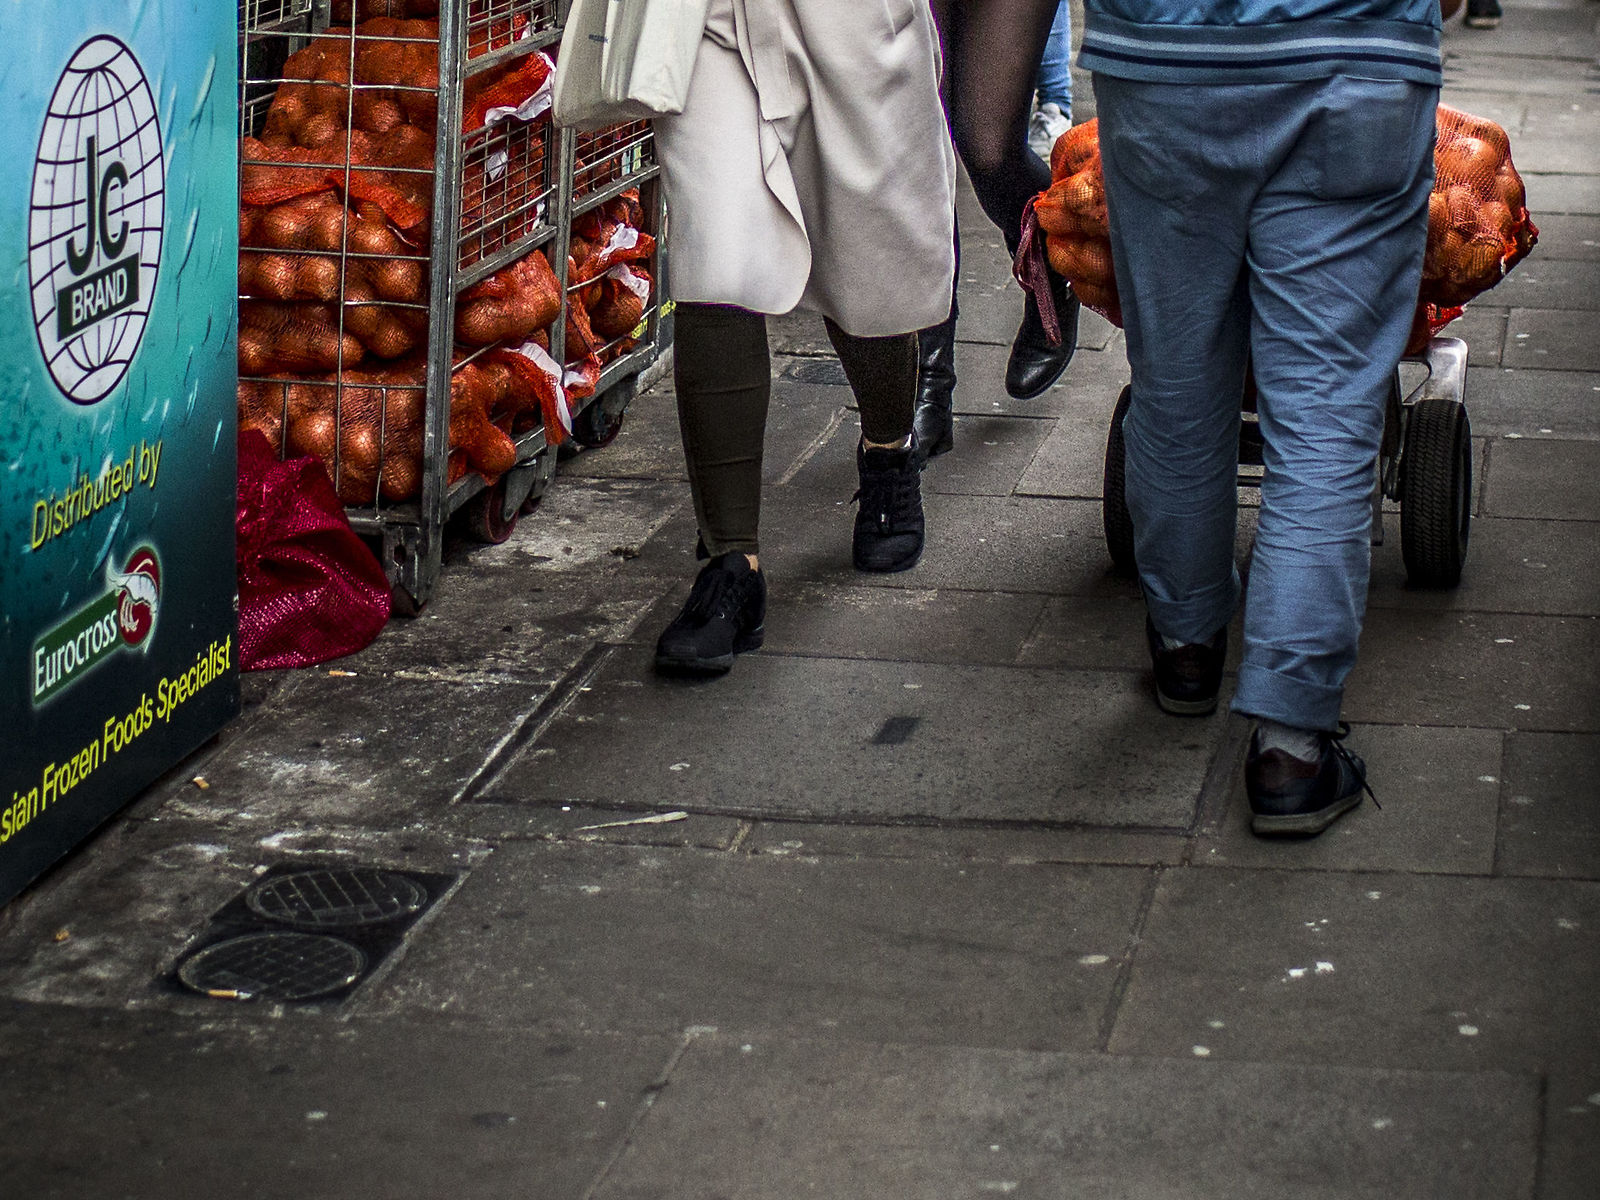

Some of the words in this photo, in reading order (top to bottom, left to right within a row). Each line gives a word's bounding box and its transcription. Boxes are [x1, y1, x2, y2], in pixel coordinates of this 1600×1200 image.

[66, 134, 130, 276] JC
[71, 267, 128, 326] BRAND
[32, 445, 136, 550] Distributed
[139, 438, 162, 489] by
[34, 608, 118, 698] Eurocross
[0, 787, 38, 844] sian
[42, 738, 100, 812] Frozen
[103, 693, 153, 763] Foods
[156, 634, 231, 723] Specialist
